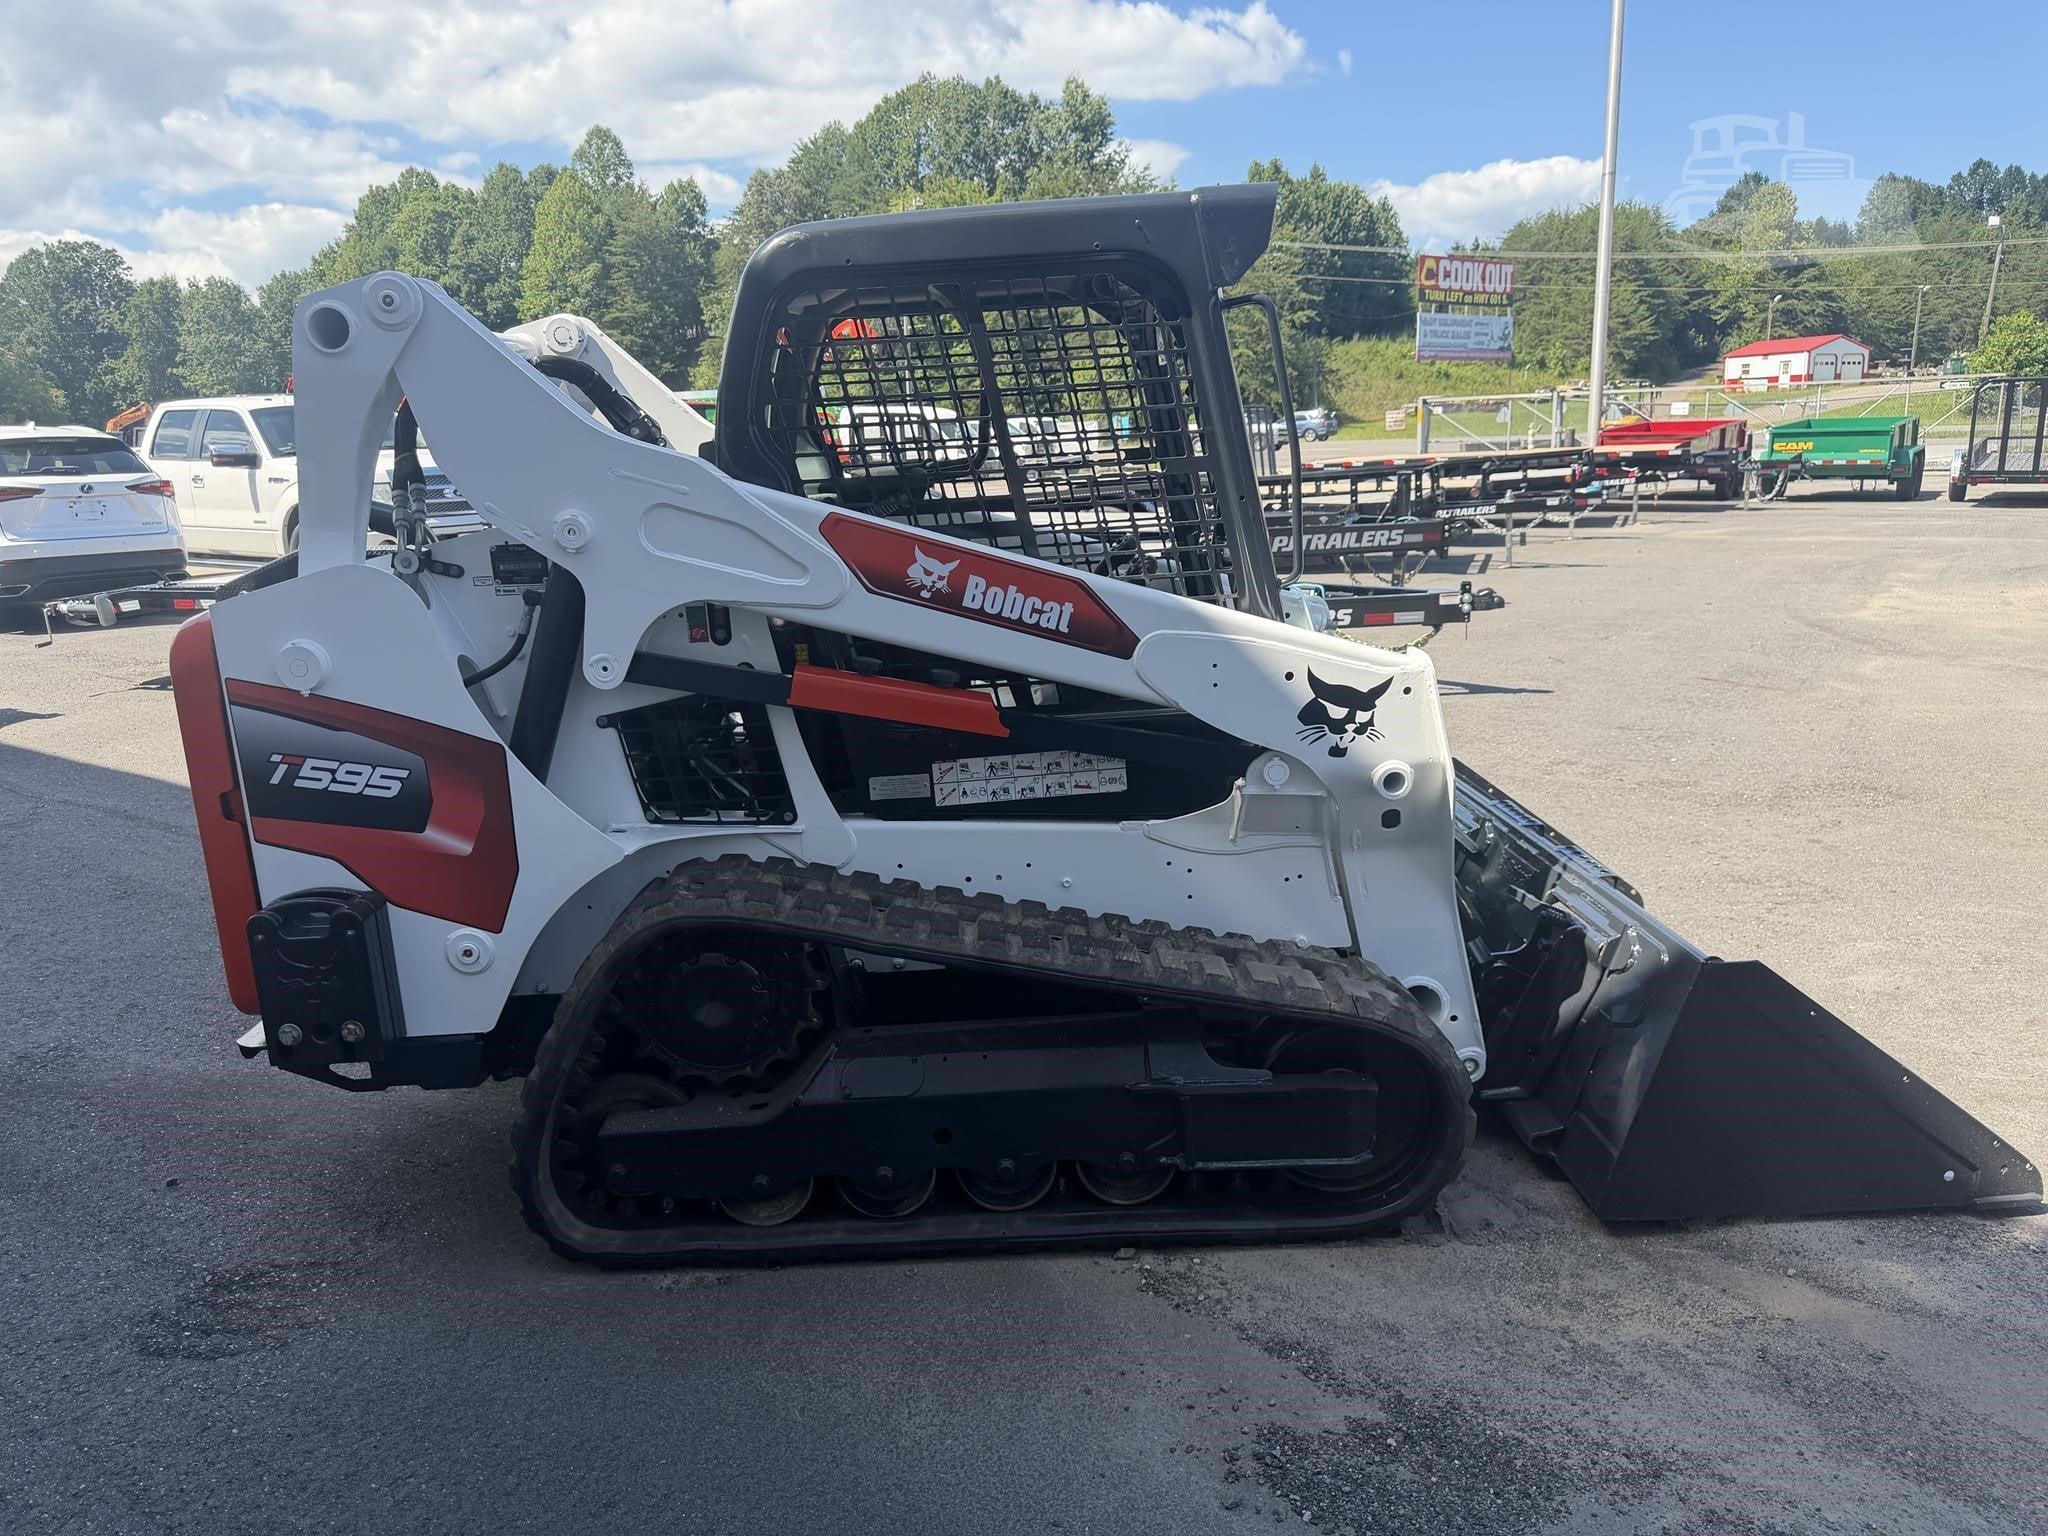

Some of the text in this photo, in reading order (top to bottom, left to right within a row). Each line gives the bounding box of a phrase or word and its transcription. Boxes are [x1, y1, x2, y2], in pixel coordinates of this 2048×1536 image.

[1439, 259, 1513, 295] COOK OUT
[1425, 290, 1444, 301] TURN
[1446, 291, 1463, 302] LEFT
[1474, 293, 1489, 303] HWY
[1773, 441, 1814, 451] CAM
[1737, 461, 1761, 470] CAM
[961, 574, 1075, 634] Bobcat
[268, 753, 411, 799] T595
